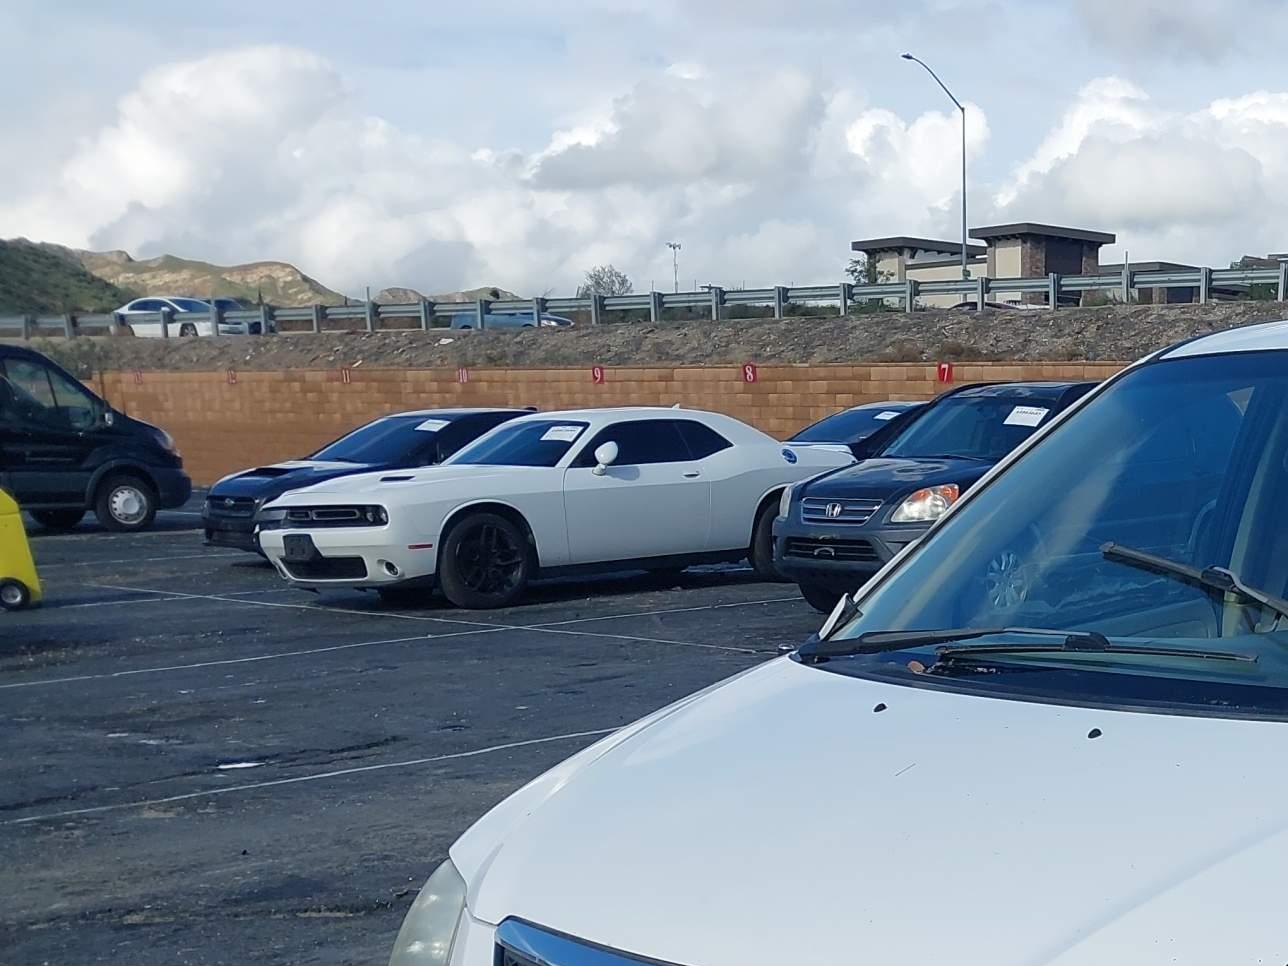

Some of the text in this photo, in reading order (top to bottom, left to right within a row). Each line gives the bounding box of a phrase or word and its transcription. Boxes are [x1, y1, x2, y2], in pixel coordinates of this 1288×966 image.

[342, 369, 351, 384] 11
[593, 366, 601, 383] 9
[745, 365, 754, 382] 8
[940, 363, 949, 382] 7
